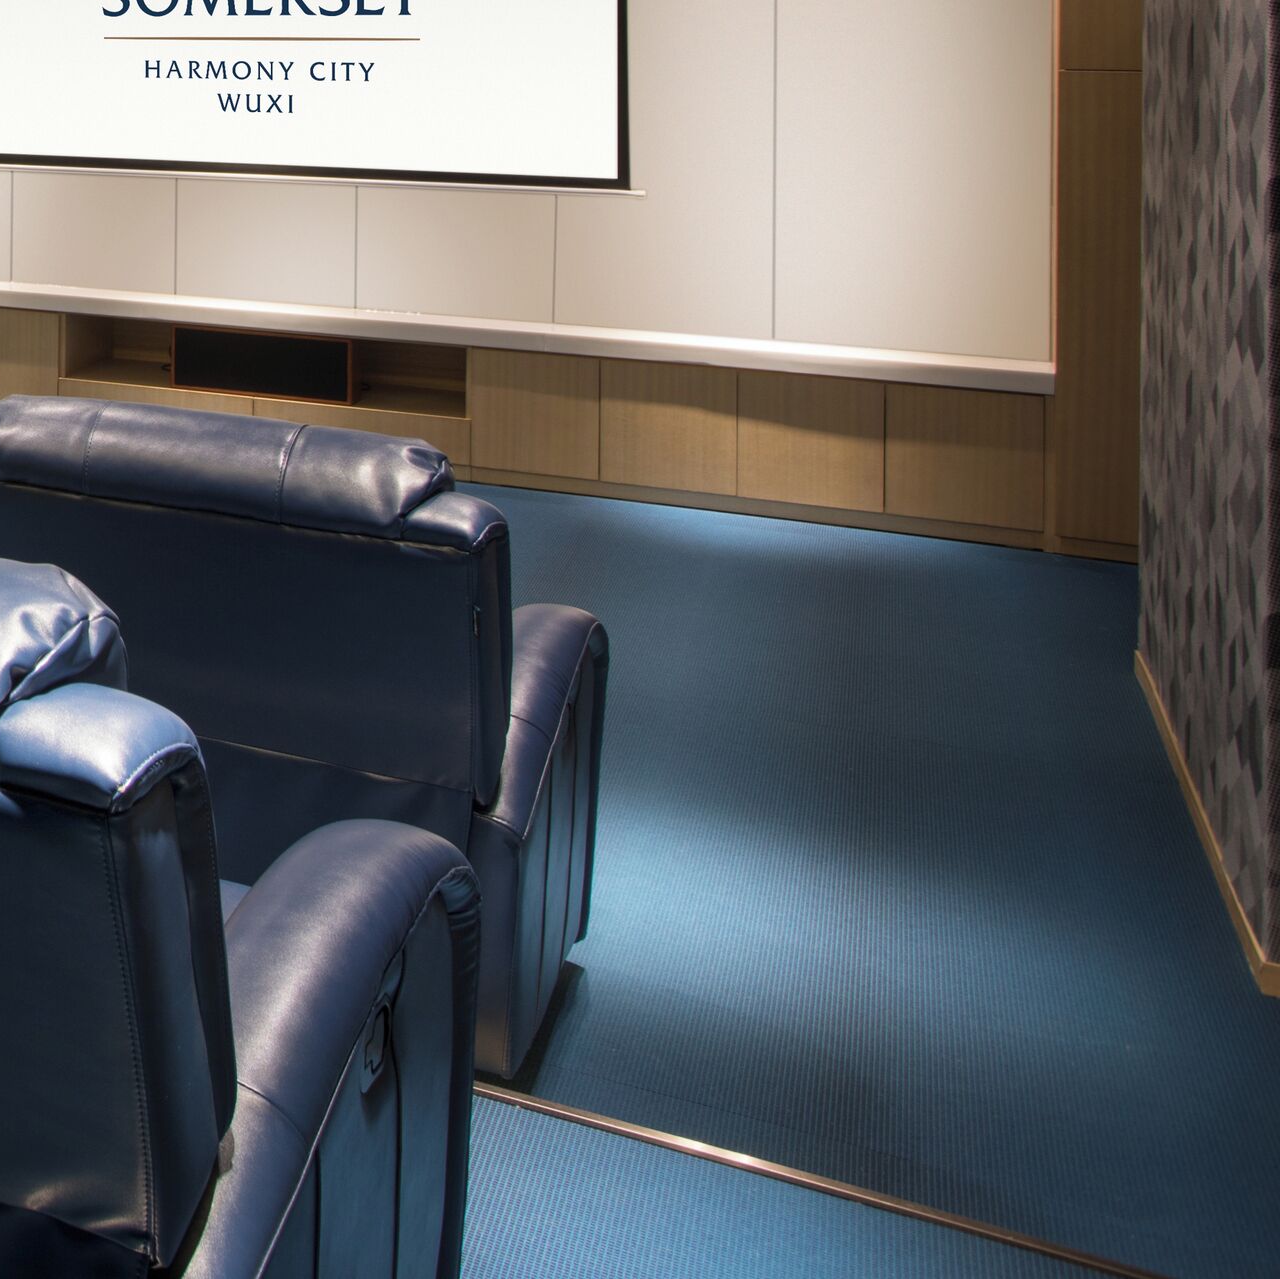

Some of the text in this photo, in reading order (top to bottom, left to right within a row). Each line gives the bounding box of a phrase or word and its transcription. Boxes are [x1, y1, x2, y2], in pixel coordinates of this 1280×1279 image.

[144, 59, 375, 82] HARMONY CITY
[217, 93, 294, 114] WUXI
